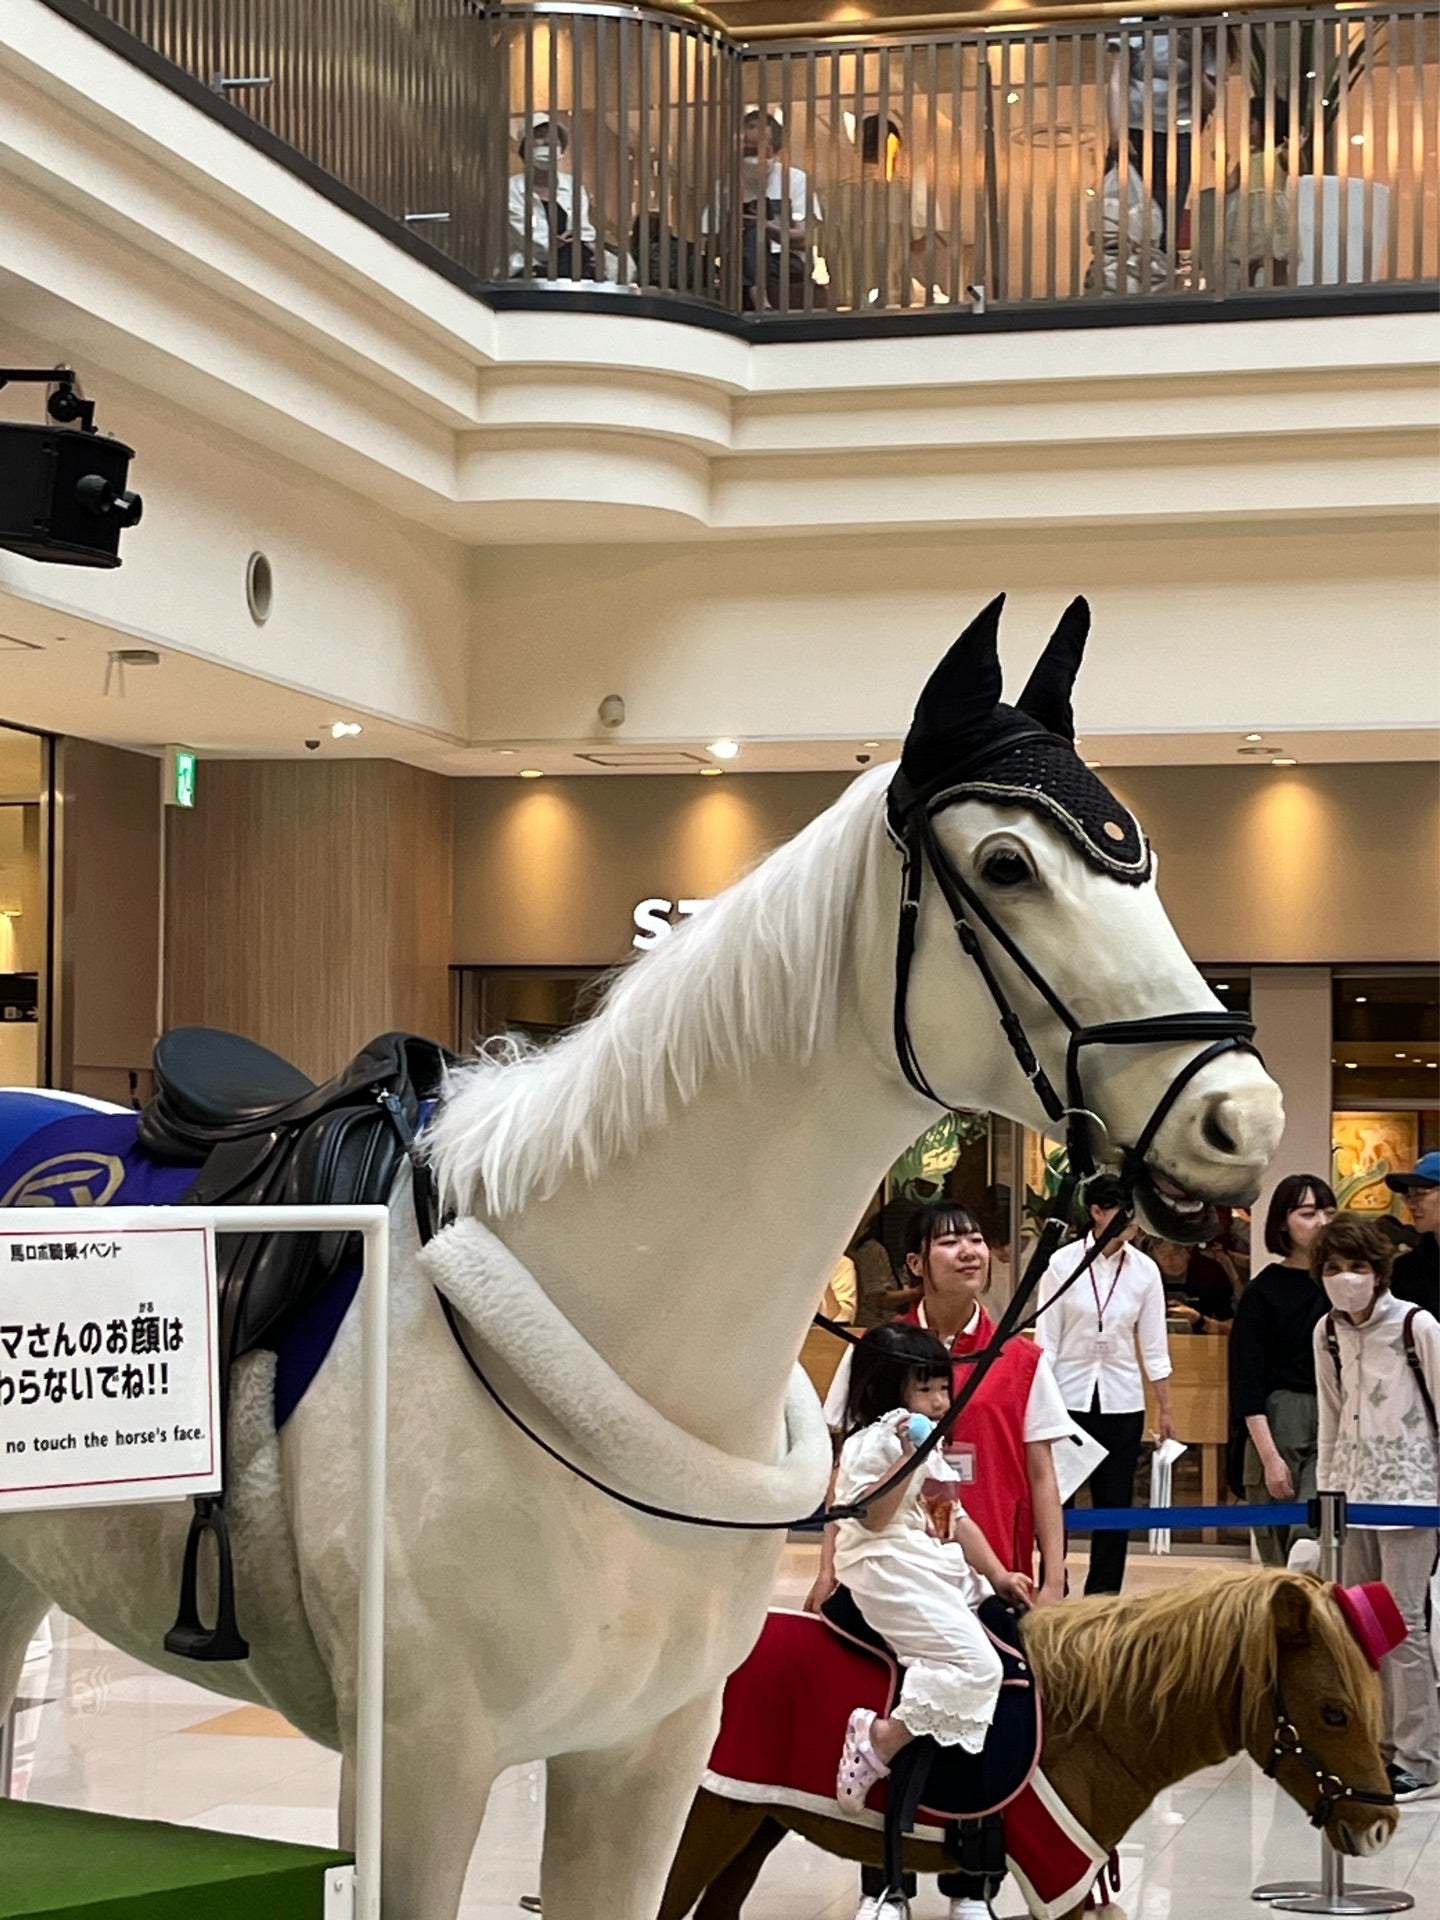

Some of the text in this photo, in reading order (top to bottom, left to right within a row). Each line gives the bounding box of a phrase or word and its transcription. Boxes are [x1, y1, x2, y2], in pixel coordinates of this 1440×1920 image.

[10, 1241, 122, 1263] 馬ロボ騎乗イベント
[0, 1315, 185, 1359] マさんのお顔は
[6, 1424, 206, 1454] no touch the horse's face.
